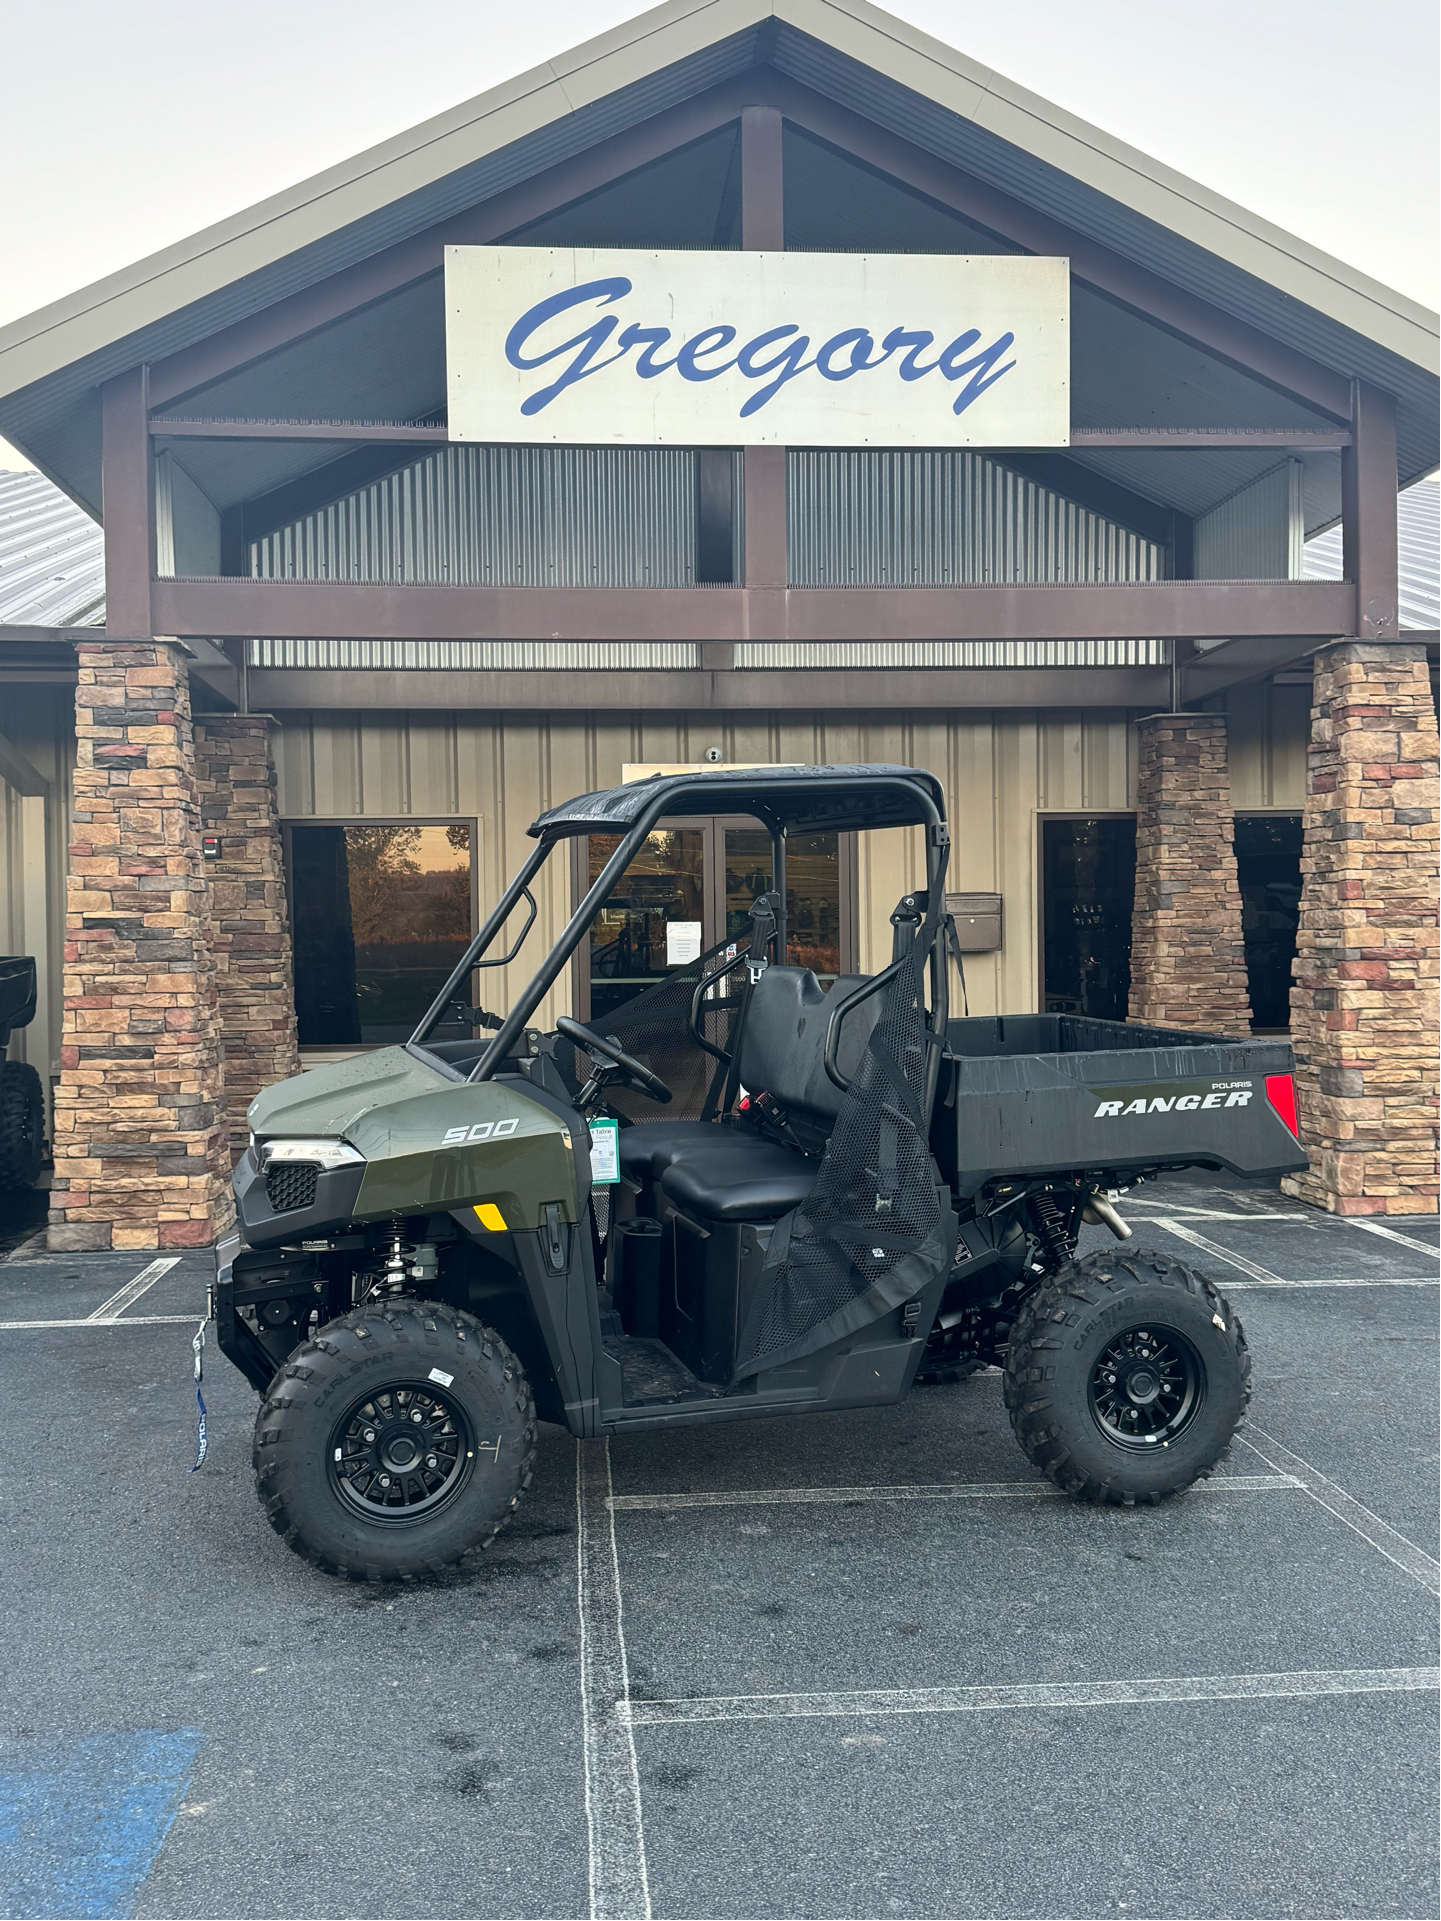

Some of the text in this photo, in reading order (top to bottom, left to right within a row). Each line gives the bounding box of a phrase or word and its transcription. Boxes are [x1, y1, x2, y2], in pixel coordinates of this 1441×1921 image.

[505, 276, 1017, 418] Gregory
[1212, 1080, 1253, 1090] POLARIS
[1093, 1091, 1254, 1118] RANGER
[441, 1118, 520, 1145] 500
